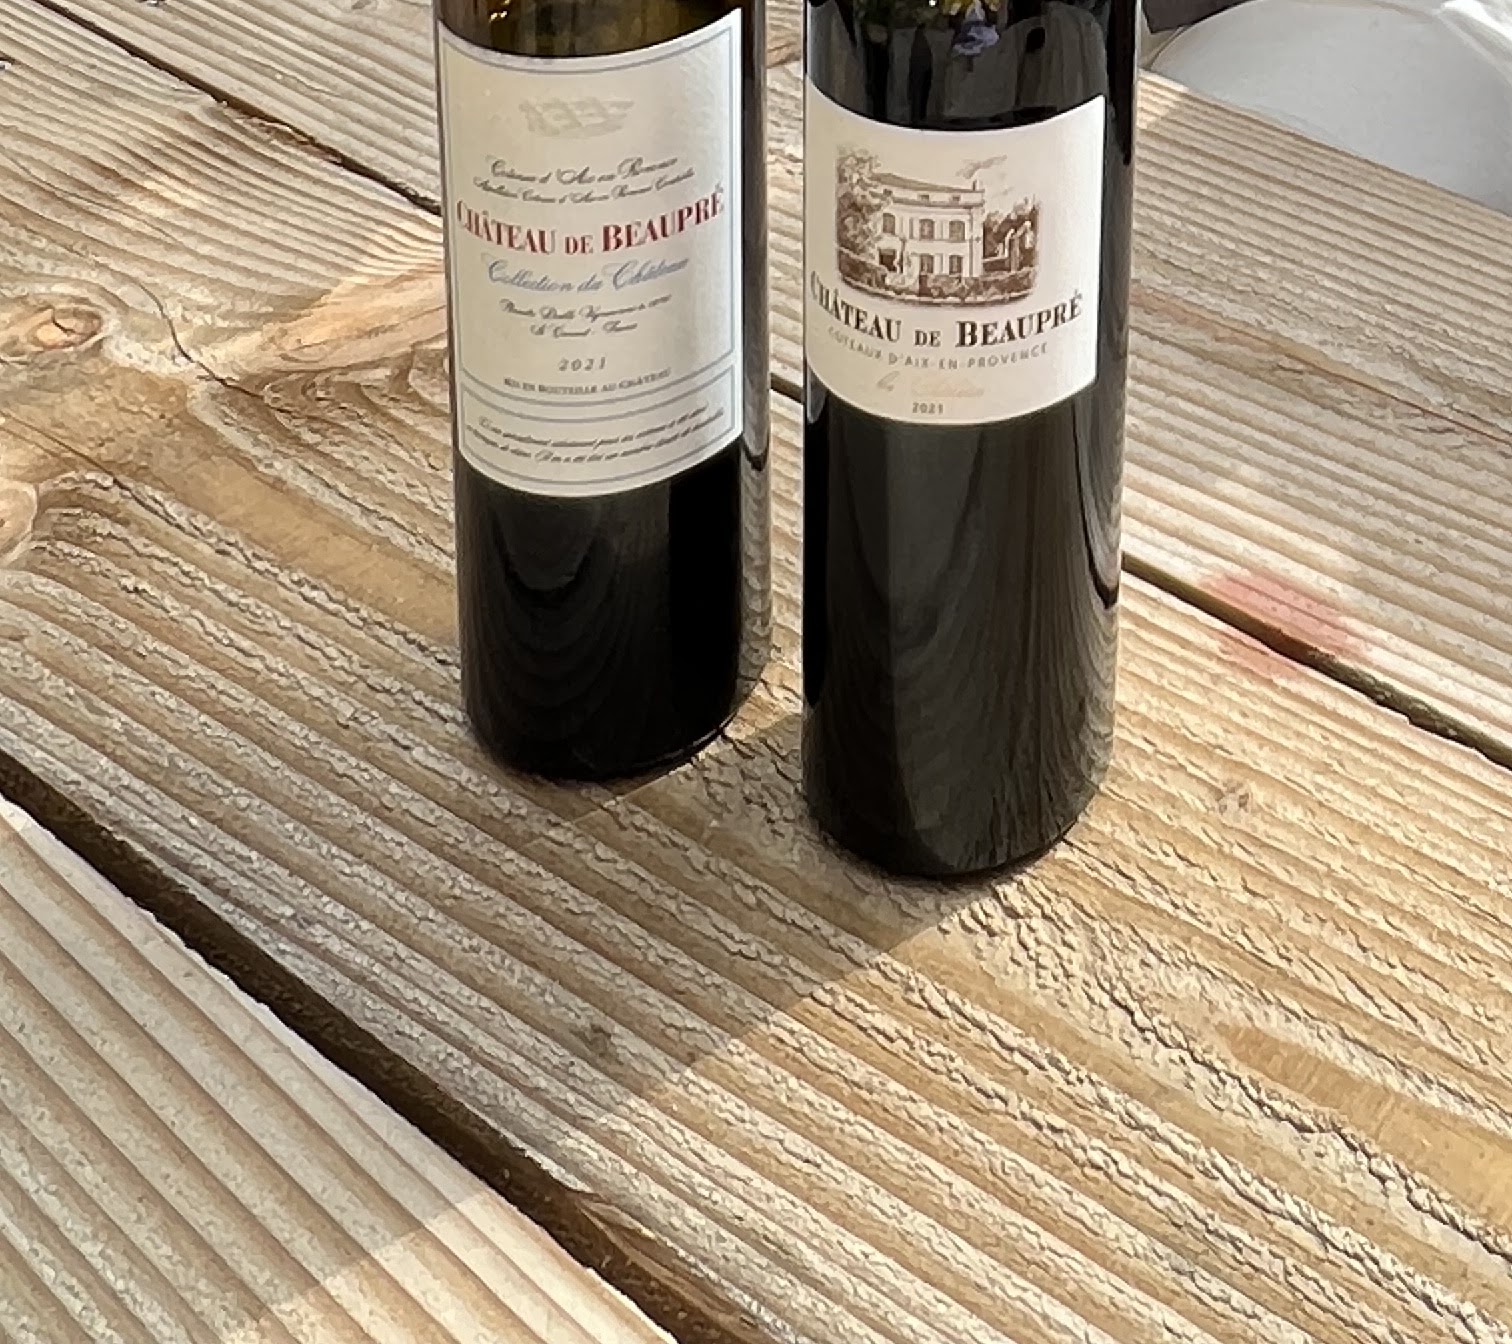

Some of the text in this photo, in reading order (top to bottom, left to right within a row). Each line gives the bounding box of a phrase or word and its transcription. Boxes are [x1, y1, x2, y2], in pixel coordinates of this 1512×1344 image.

[456, 199, 557, 255] CHÂTEAU
[564, 234, 594, 255] DE
[601, 182, 725, 253] BEAUPRÉ
[810, 270, 1083, 348] CHÂTEAU DE BEAUPRÉ
[558, 357, 607, 372] 2021
[911, 402, 944, 415] 2021
